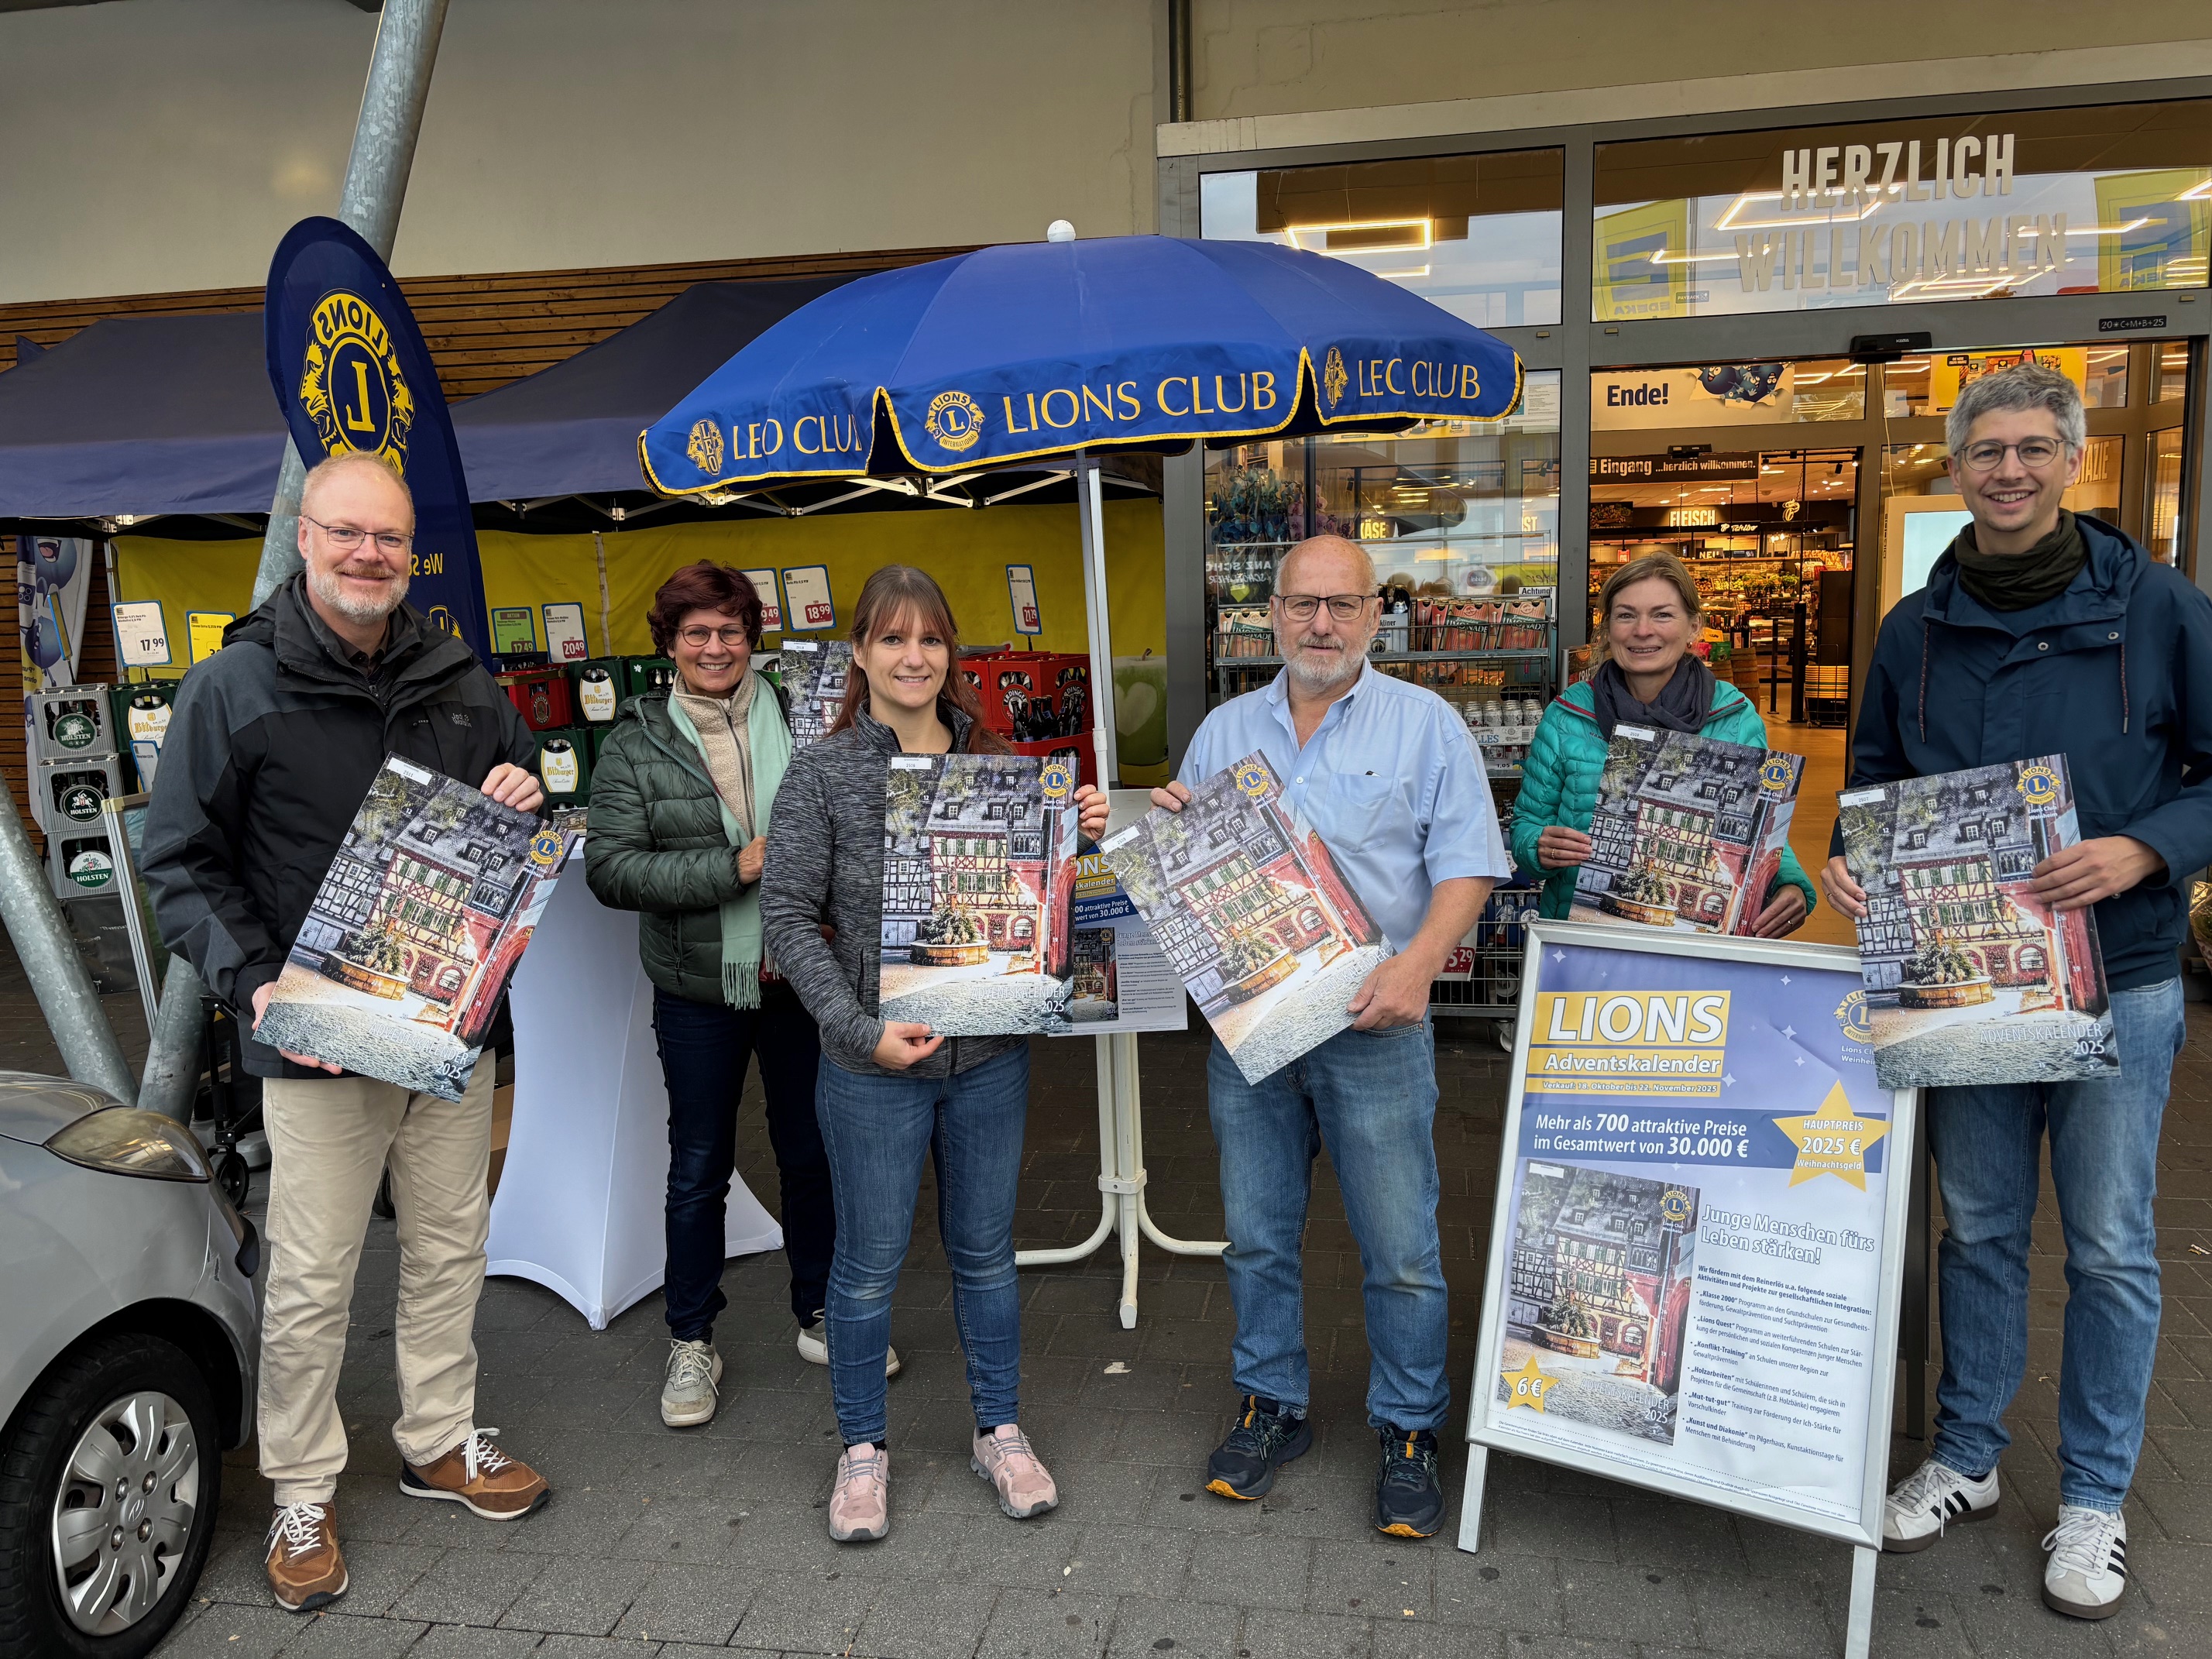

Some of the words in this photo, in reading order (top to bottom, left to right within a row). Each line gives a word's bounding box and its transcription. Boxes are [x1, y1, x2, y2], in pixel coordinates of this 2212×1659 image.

[1781, 133, 2015, 211] HERZLICH
[1735, 212, 2067, 294] WILLKOMMEN
[1411, 360, 1481, 399] CLUB
[933, 393, 968, 409] LIONS
[1002, 380, 1142, 434] LIONS
[1156, 371, 1276, 417] CLUB
[1607, 383, 1668, 407] Ende!
[946, 410, 966, 432] L
[733, 418, 783, 460] LEO
[942, 433, 977, 448] INTERNATIONAL
[1600, 459, 1652, 476] Eingang
[1655, 461, 1698, 472] ...herzlich
[1700, 459, 1756, 470] willkommen.
[1670, 510, 1716, 527] FLEISCH
[807, 605, 830, 620] 18.99
[140, 637, 164, 651] 17.99
[564, 641, 585, 654] 20.49
[60, 733, 91, 741] HOLSTEN
[1238, 764, 1255, 778] LIONS
[1768, 759, 1789, 768] LIONS
[1052, 775, 1060, 786] L
[1246, 775, 1259, 786] L
[1771, 768, 1781, 780] L
[2023, 767, 2049, 778] LIONS
[2032, 778, 2045, 792] L
[70, 807, 97, 816] HOLSTEN
[541, 832, 561, 843] LIONS
[541, 840, 551, 854] L
[77, 873, 109, 882] HOLSTEN
[1084, 902, 1110, 912] attraktive
[1111, 899, 1128, 908] Preise
[1099, 906, 1123, 917] 30.000
[1125, 905, 1130, 913] €
[970, 986, 1066, 999] ADVENTSKALENDER
[1041, 1000, 1065, 1013] 2025
[1547, 995, 1725, 1042] LIONS
[1980, 1023, 2103, 1043] ADVENTSKALENDER
[369, 1020, 469, 1066] ADVENTSKALENDER
[1842, 1046, 1862, 1054] Lions
[2073, 1040, 2105, 1056] 2025
[435, 1060, 462, 1080] 2025
[1544, 1053, 1722, 1073] Adventskalender
[1543, 1081, 1576, 1090] Verkauf:
[1591, 1082, 1623, 1091] Oktober
[1626, 1083, 1637, 1091] bis
[1653, 1084, 1695, 1093] November
[1536, 1114, 1571, 1130] Mehr
[1573, 1115, 1592, 1131] als
[1595, 1113, 1629, 1132] 700
[1631, 1118, 1701, 1135] attraktive
[1704, 1120, 1747, 1136] Preise
[1802, 1119, 1864, 1132] HAUPTPREIS
[1534, 1135, 1550, 1149] im
[1554, 1135, 1636, 1153] Gesamtwert
[1639, 1142, 1664, 1154] von
[1668, 1137, 1733, 1156] 30.000
[1736, 1139, 1750, 1158] €
[1801, 1136, 1845, 1156] 2025
[1849, 1138, 1861, 1156] €
[1797, 1159, 1862, 1171] Weihnachtsgeld
[1665, 1190, 1687, 1201] LIONS
[1671, 1200, 1681, 1211] L
[1702, 1204, 1751, 1231] Junge
[1753, 1213, 1836, 1245] Menschen
[1840, 1230, 1875, 1252] fürs
[1701, 1226, 1750, 1252] Leben
[1752, 1238, 1822, 1266] stärken!
[1709, 1266, 1729, 1276] fördern
[1742, 1273, 1754, 1282] dem
[1756, 1276, 1783, 1287] Reinerlös
[1798, 1284, 1824, 1296] folgende
[1826, 1292, 1846, 1300] soziale
[1697, 1273, 1728, 1285] Aktivitäten
[1742, 1282, 1766, 1293] Projekte
[1778, 1291, 1832, 1307] gesellschaftlichen
[1834, 1301, 1871, 1315] Integration:
[1698, 1298, 1724, 1312] förderung,
[1725, 1305, 1771, 1320] Gewaltprävention
[1784, 1317, 1827, 1332] Suchtprävention
[1738, 1297, 1767, 1309] Programm
[1786, 1307, 1823, 1321] Grundschulen
[1833, 1318, 1870, 1331] Gesundheits-
[1693, 1349, 1738, 1365] Gewaltprävention
[1757, 1354, 1778, 1365] Schulen
[1778, 1361, 1798, 1369] unserer
[1799, 1364, 1819, 1374] Region
[1516, 1377, 1528, 1396] 6
[1530, 1378, 1543, 1397] €
[1580, 1378, 1669, 1411] ADVENTSKALENDER
[1688, 1400, 1726, 1415] Vorschulkinder
[1644, 1408, 1668, 1424] 2025
[1731, 1401, 1753, 1413] Training
[1763, 1410, 1791, 1424] Förderung
[1792, 1416, 1802, 1424] der
[1803, 1419, 1832, 1431] Ich-Stärke
